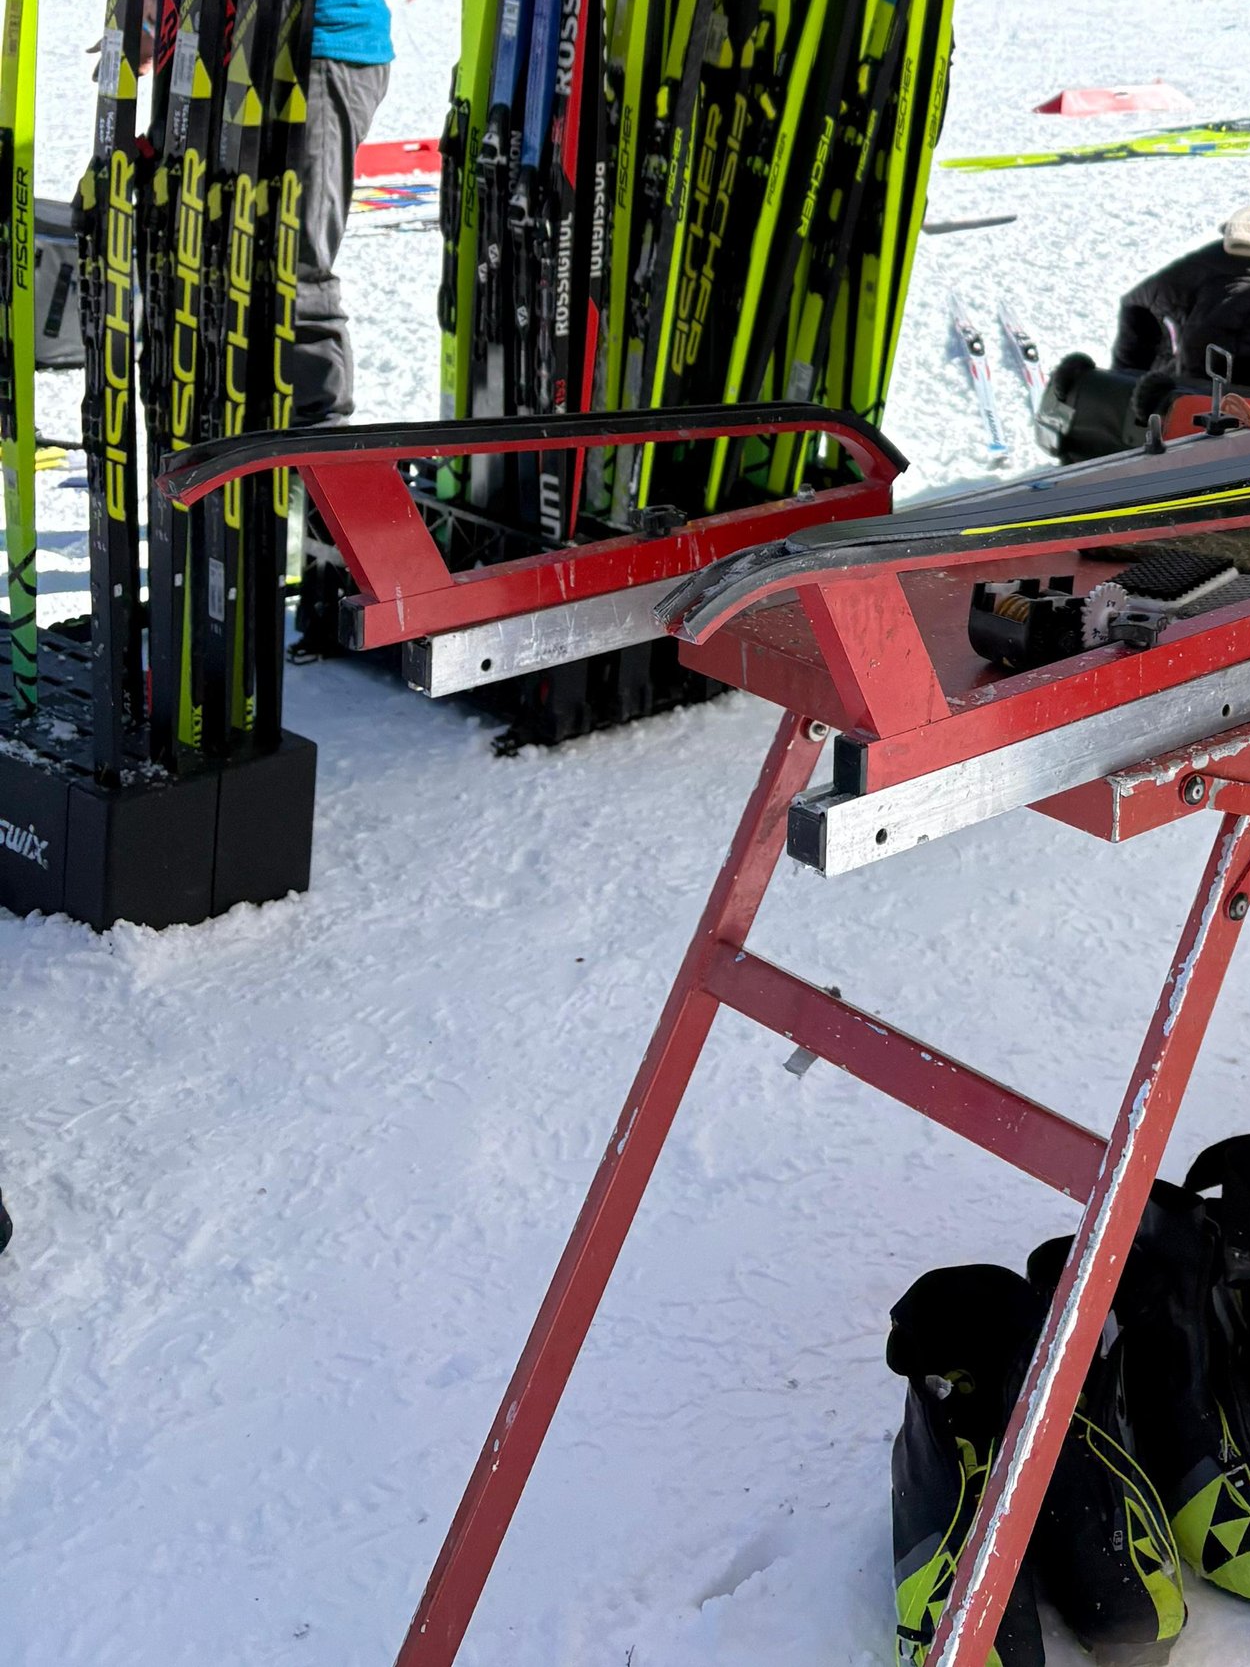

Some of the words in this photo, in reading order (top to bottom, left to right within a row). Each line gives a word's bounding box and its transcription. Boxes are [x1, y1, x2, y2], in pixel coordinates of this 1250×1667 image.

[856, 108, 878, 183] FISCHER
[895, 57, 913, 152] FISCHER
[928, 56, 947, 150] FISCHER
[463, 125, 480, 229] FISCHER
[618, 105, 634, 209] FISCHER
[766, 131, 788, 206] FISCHER
[797, 115, 835, 238] FISCHER
[15, 166, 29, 291] FISCHER
[103, 150, 137, 521] FISCHER
[172, 147, 207, 454] ISCHER
